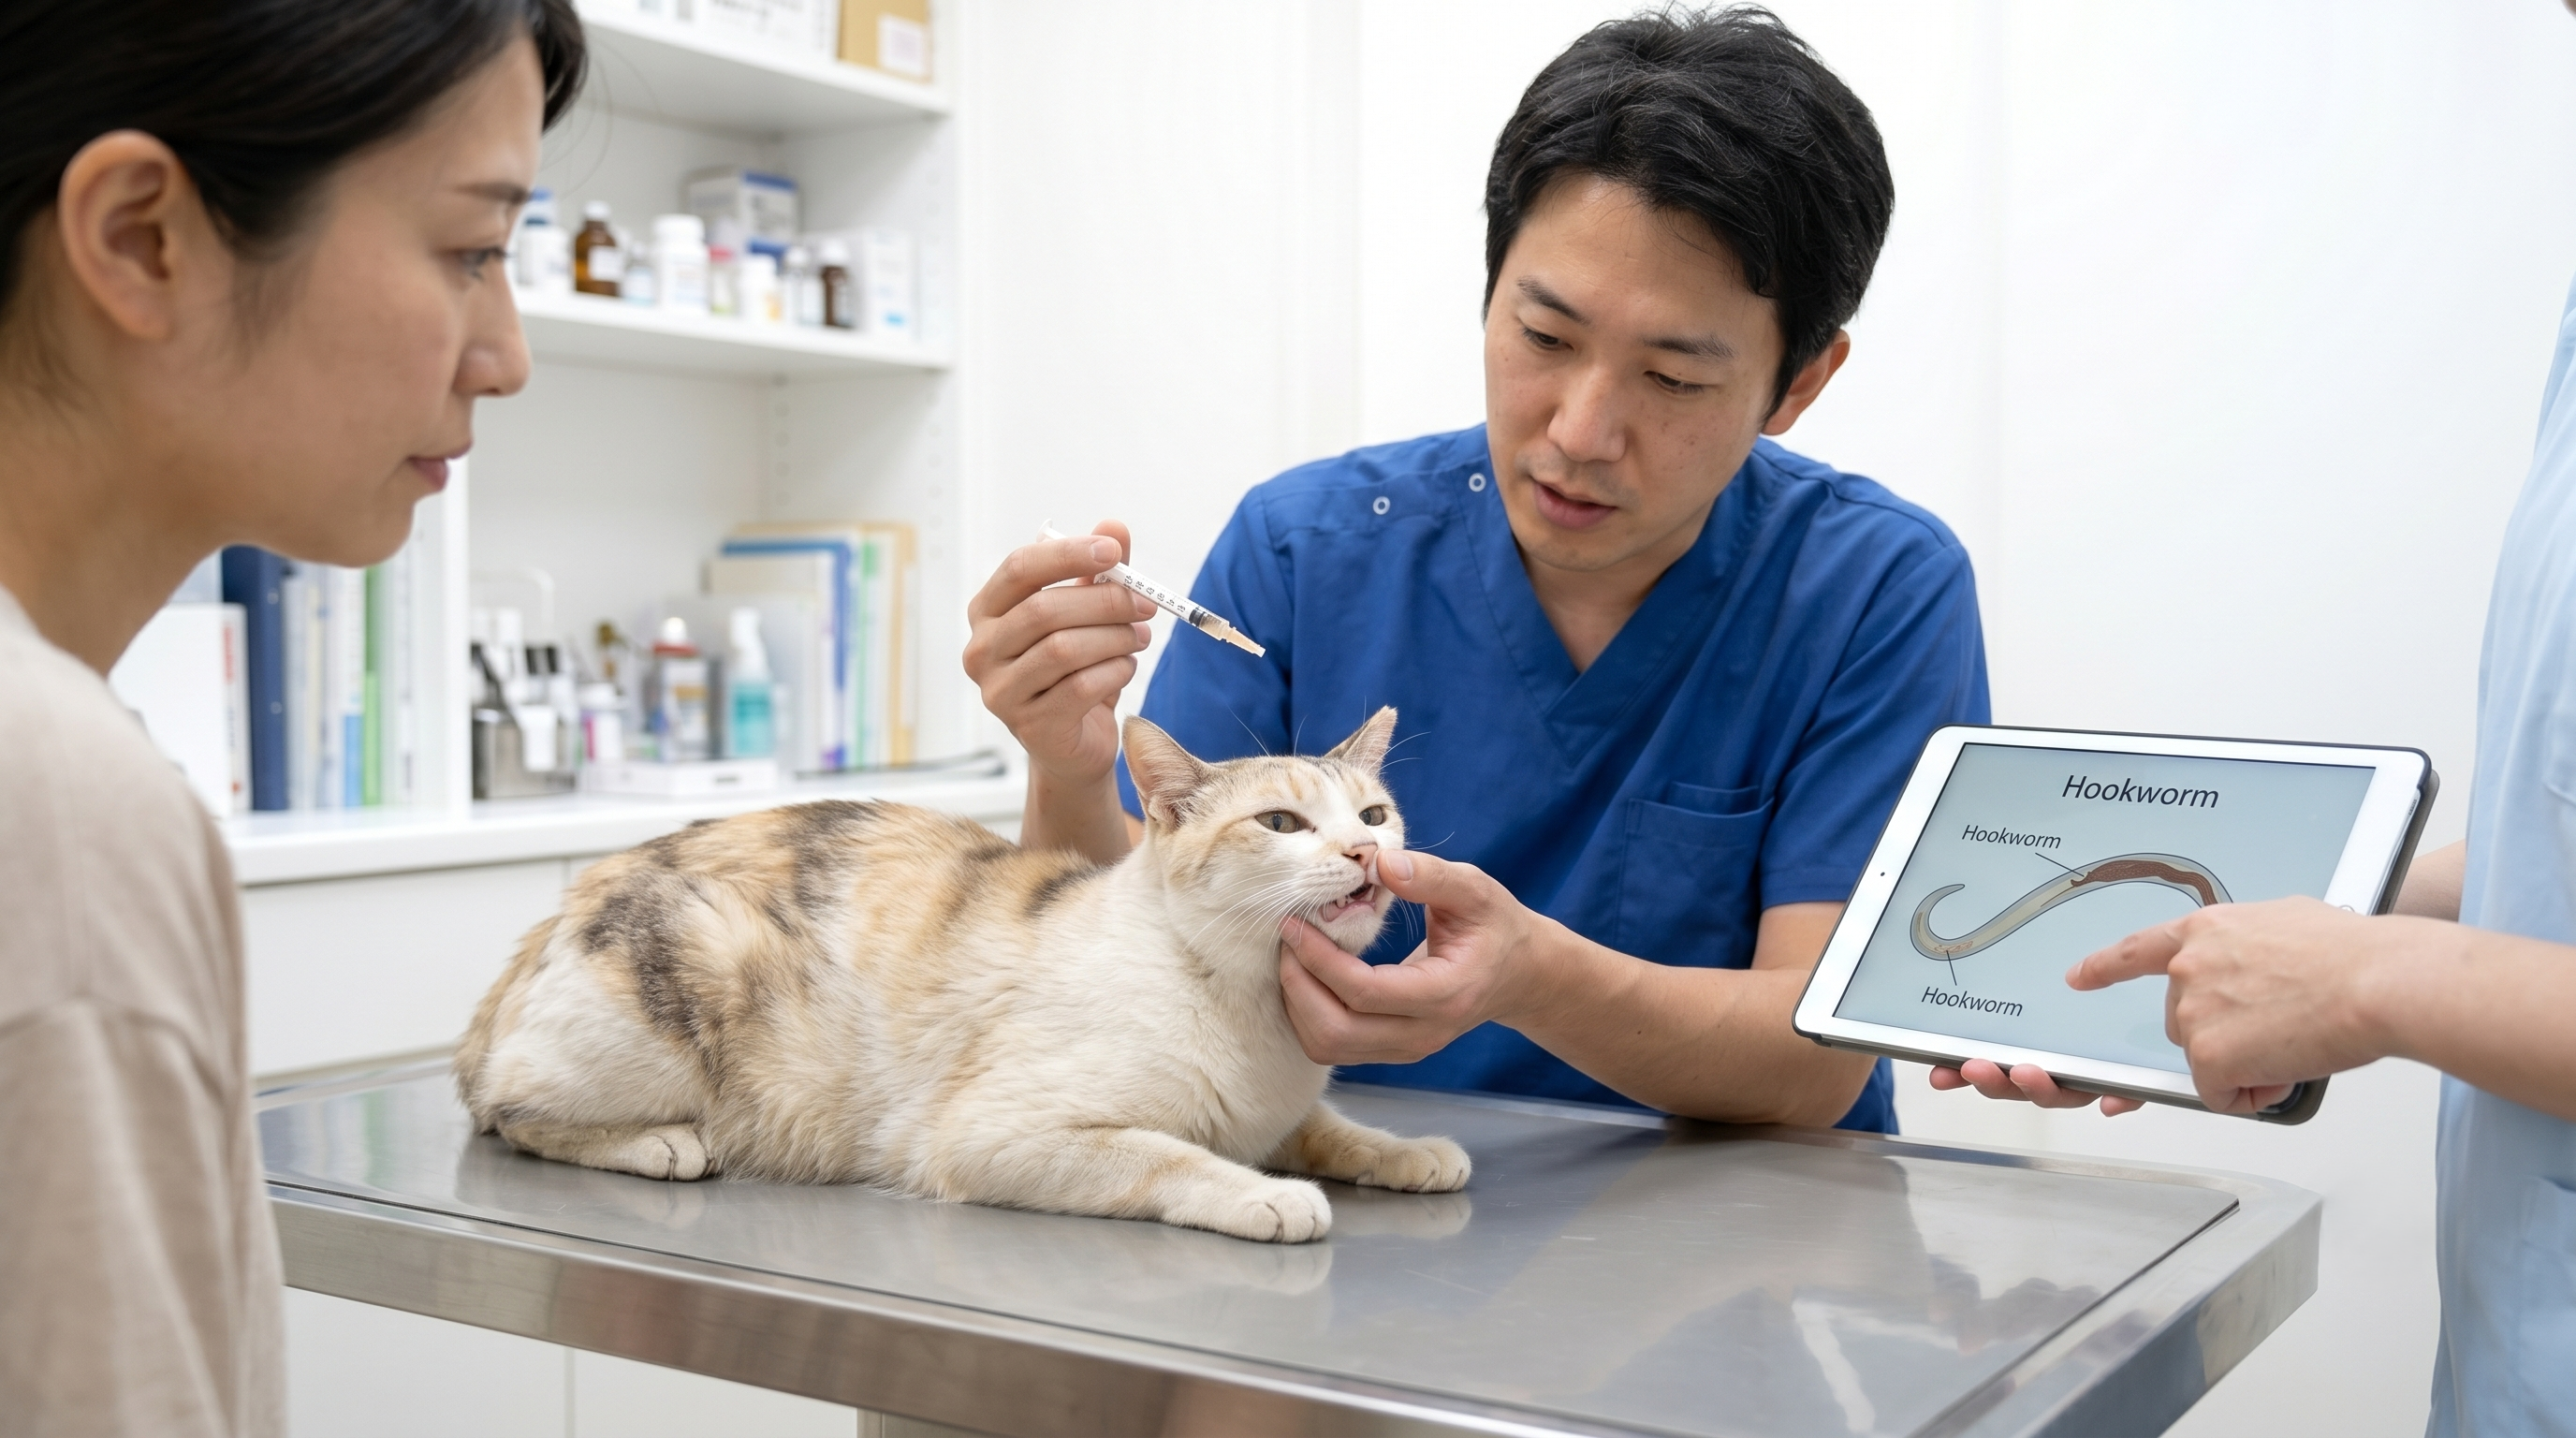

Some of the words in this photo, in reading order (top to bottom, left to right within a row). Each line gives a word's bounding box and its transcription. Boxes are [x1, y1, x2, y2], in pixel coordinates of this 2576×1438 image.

[2061, 774, 2219, 809] Hookworm
[1961, 824, 2061, 849] Hookworm
[1921, 986, 2024, 1018] Hookworm
